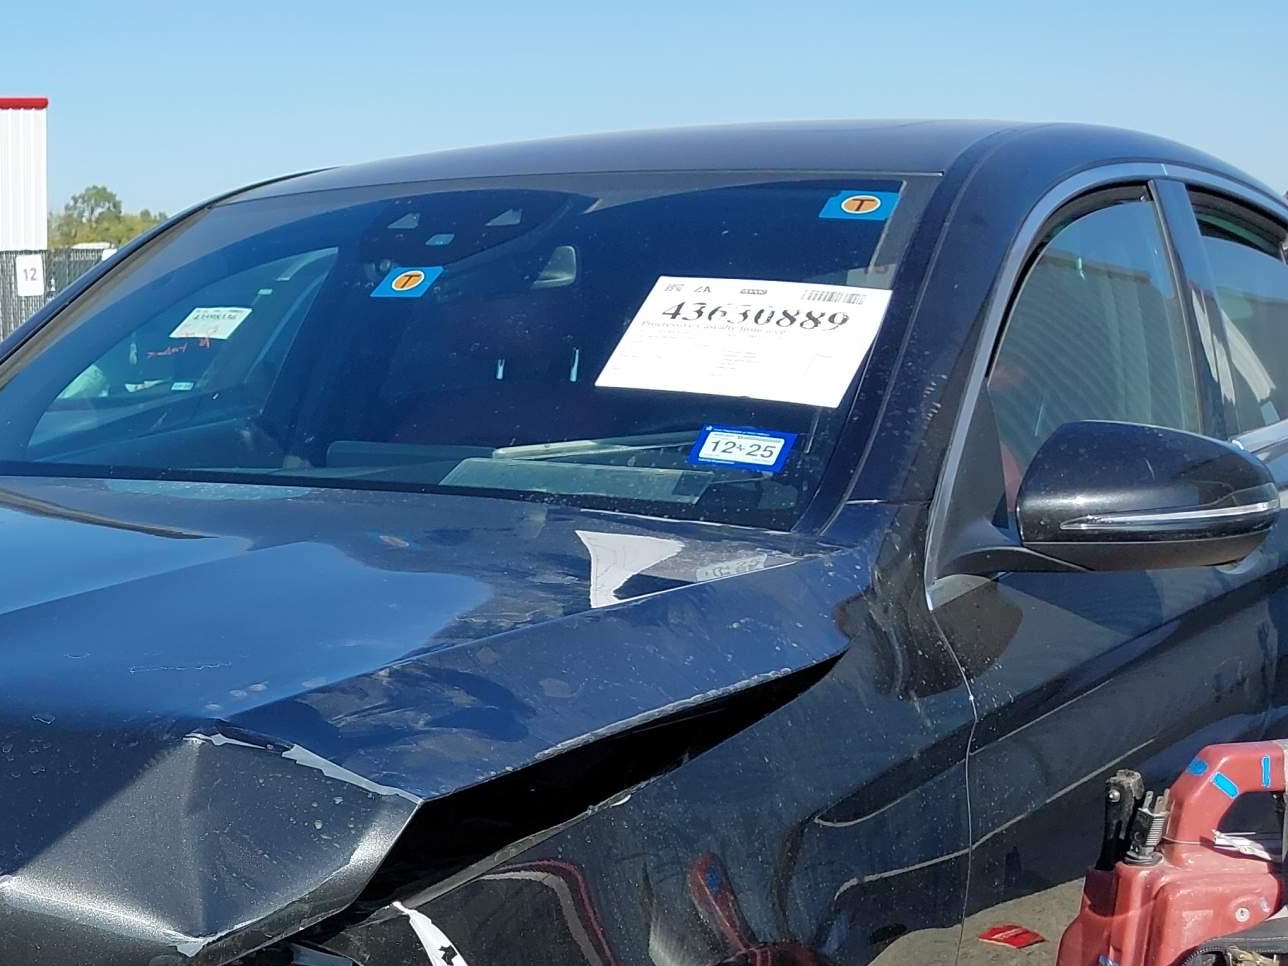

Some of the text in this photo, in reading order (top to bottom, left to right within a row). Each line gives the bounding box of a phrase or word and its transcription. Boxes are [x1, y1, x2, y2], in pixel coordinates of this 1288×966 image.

[23, 267, 37, 281] 12
[661, 301, 850, 331] 43630889
[711, 439, 737, 454] 12
[746, 443, 776, 459] 25
